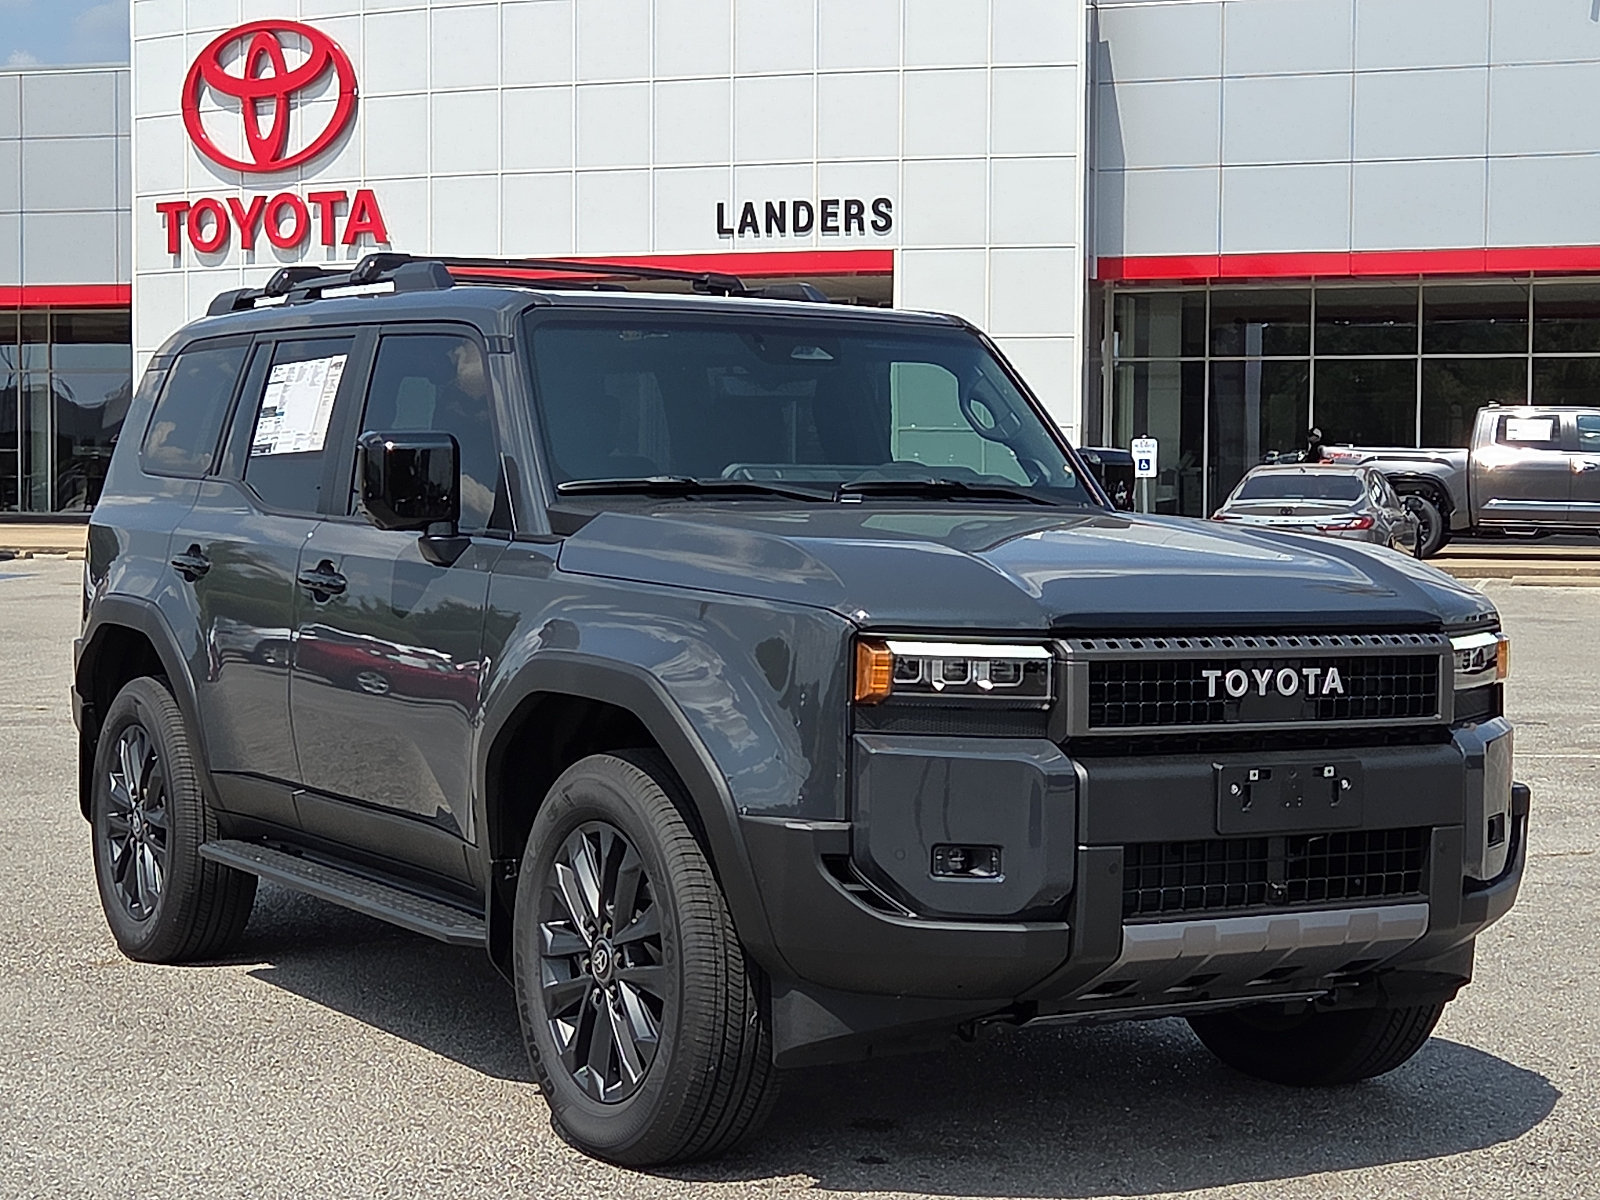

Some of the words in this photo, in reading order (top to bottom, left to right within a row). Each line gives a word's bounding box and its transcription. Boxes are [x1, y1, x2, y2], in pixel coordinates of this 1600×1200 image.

[156, 189, 389, 254] TOYOTA
[717, 197, 893, 237] LANDERS
[1202, 666, 1344, 697] TOYOTA
